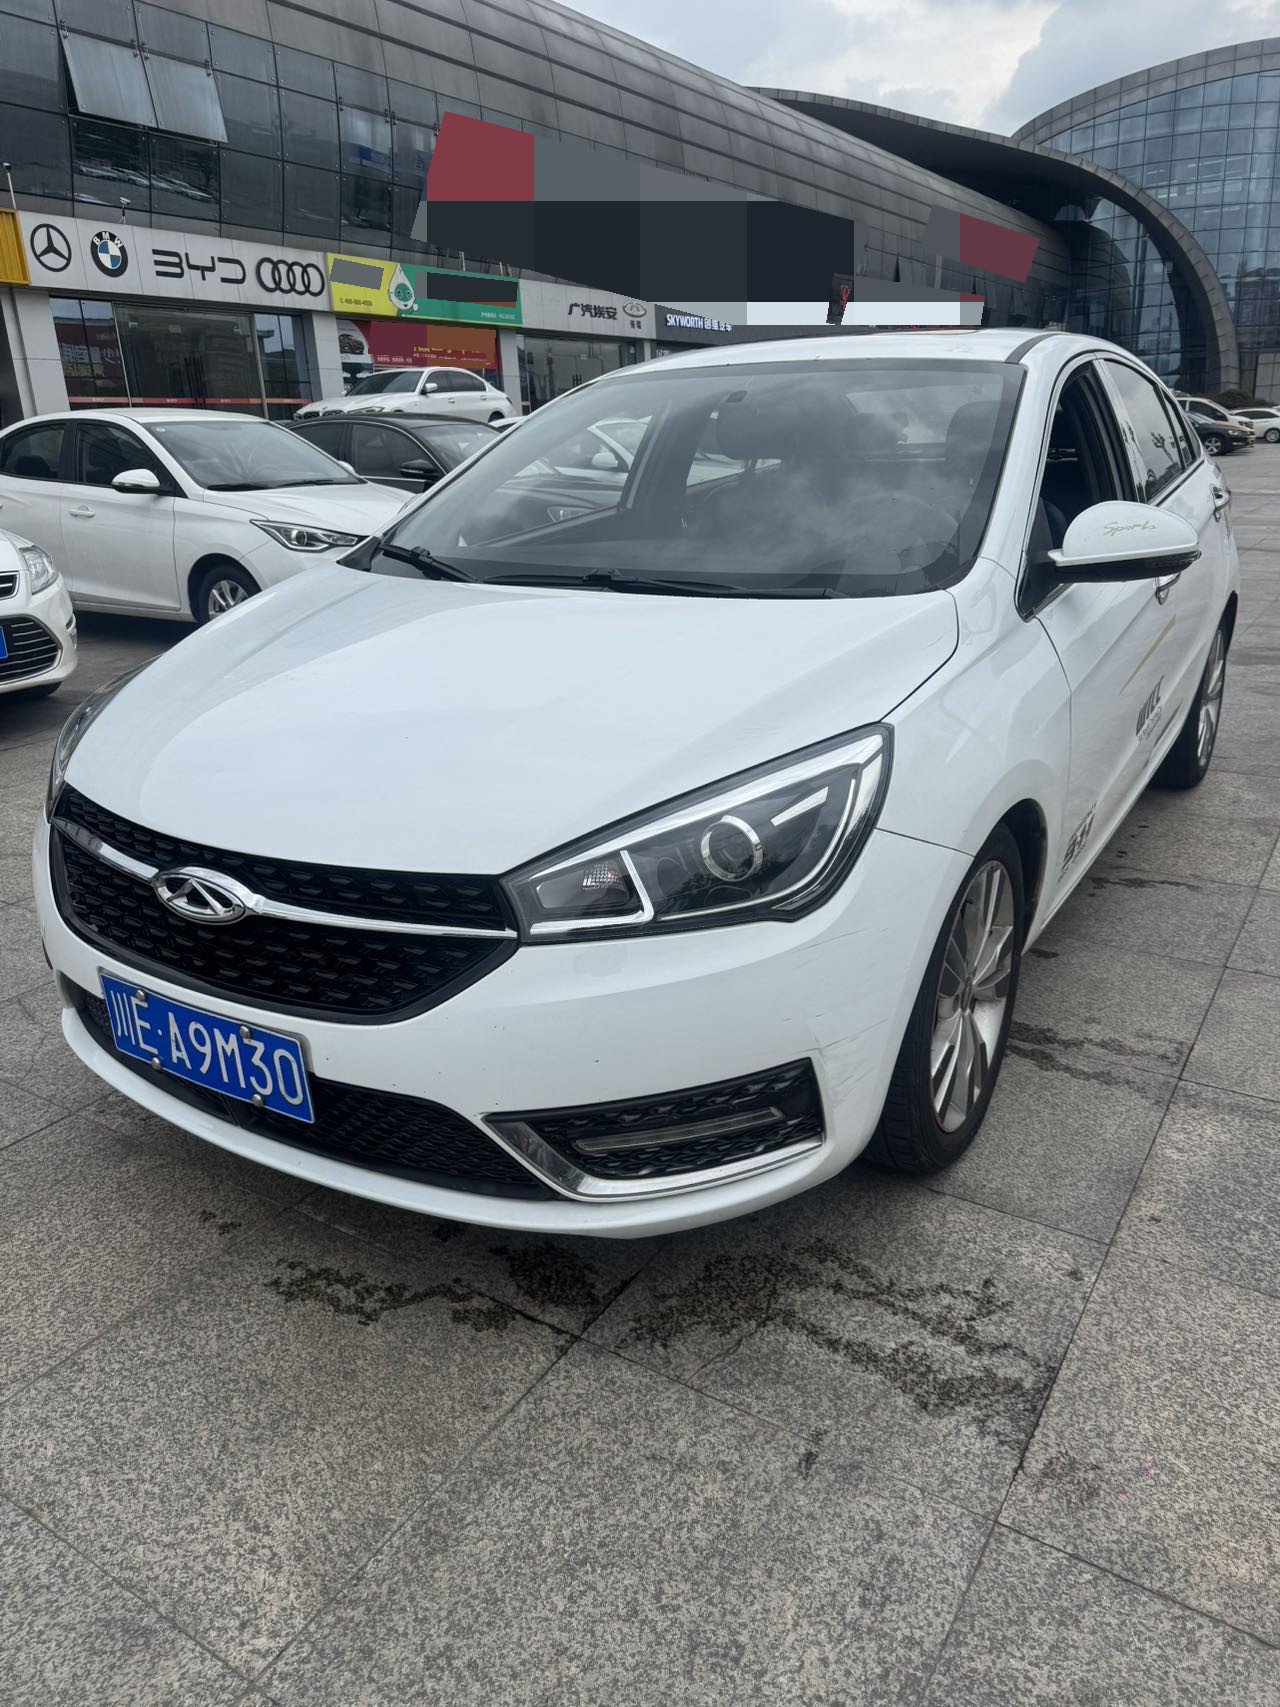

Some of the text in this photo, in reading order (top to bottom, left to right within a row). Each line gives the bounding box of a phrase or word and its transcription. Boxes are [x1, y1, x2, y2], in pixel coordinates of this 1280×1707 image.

[93, 231, 123, 248] BMW
[151, 248, 247, 284] BYD
[567, 302, 618, 320] 广汽埃安
[666, 313, 704, 329] SKYWORTH
[1103, 520, 1158, 537] Sports
